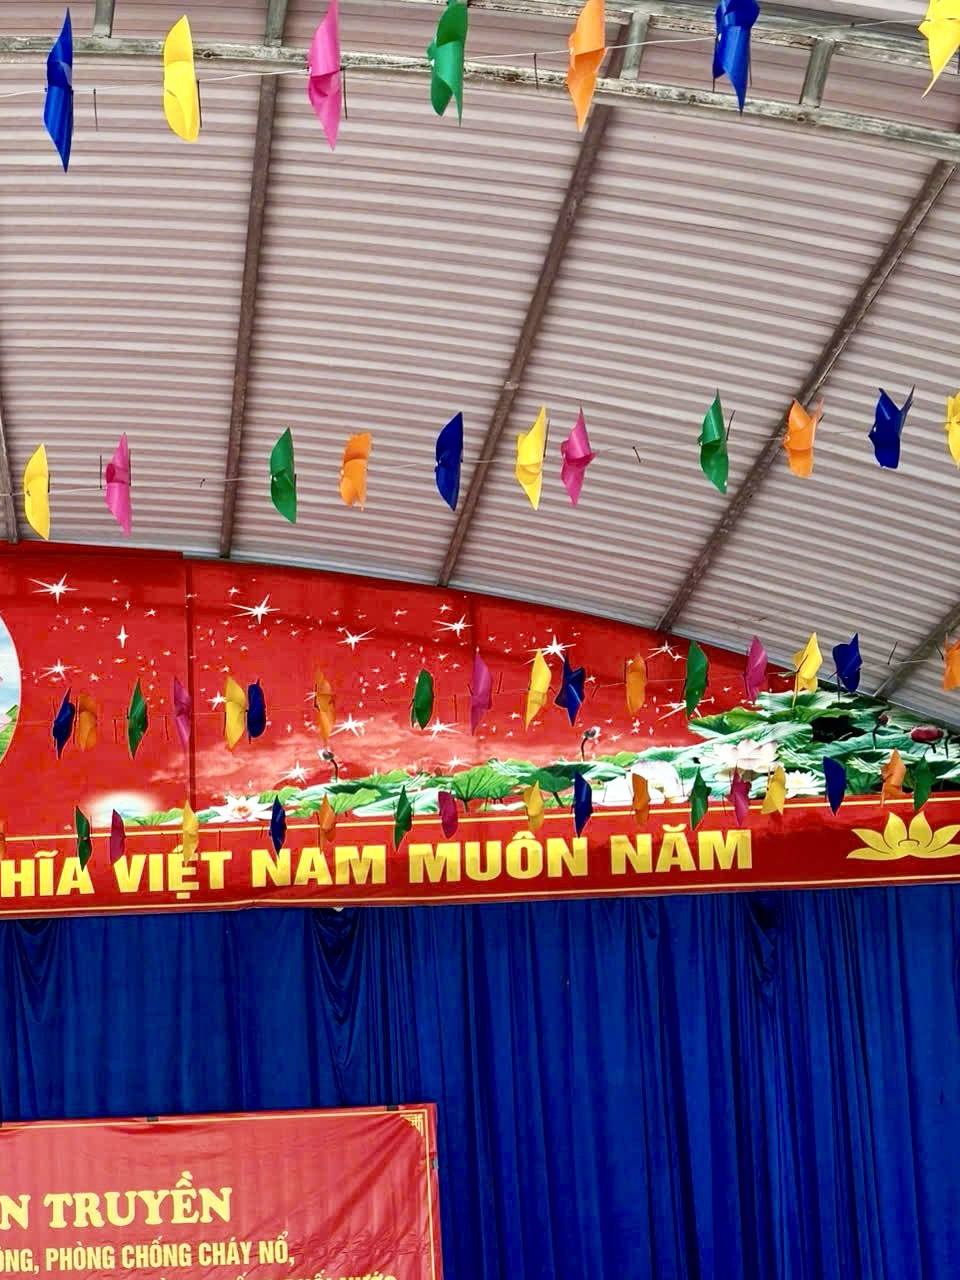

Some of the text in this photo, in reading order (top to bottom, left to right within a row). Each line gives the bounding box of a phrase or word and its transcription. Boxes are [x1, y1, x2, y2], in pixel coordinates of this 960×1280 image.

[113, 844, 232, 899] VIỆT
[252, 845, 386, 888] NAM
[409, 831, 588, 883] MUÔN
[610, 824, 752, 875] NĂM
[43, 1171, 232, 1229] TRUYỀN
[45, 1241, 115, 1270] PHÒNG
[121, 1236, 192, 1269] CHỐNG
[198, 1237, 252, 1265] CHÁY
[259, 1231, 294, 1266] NỔ,
